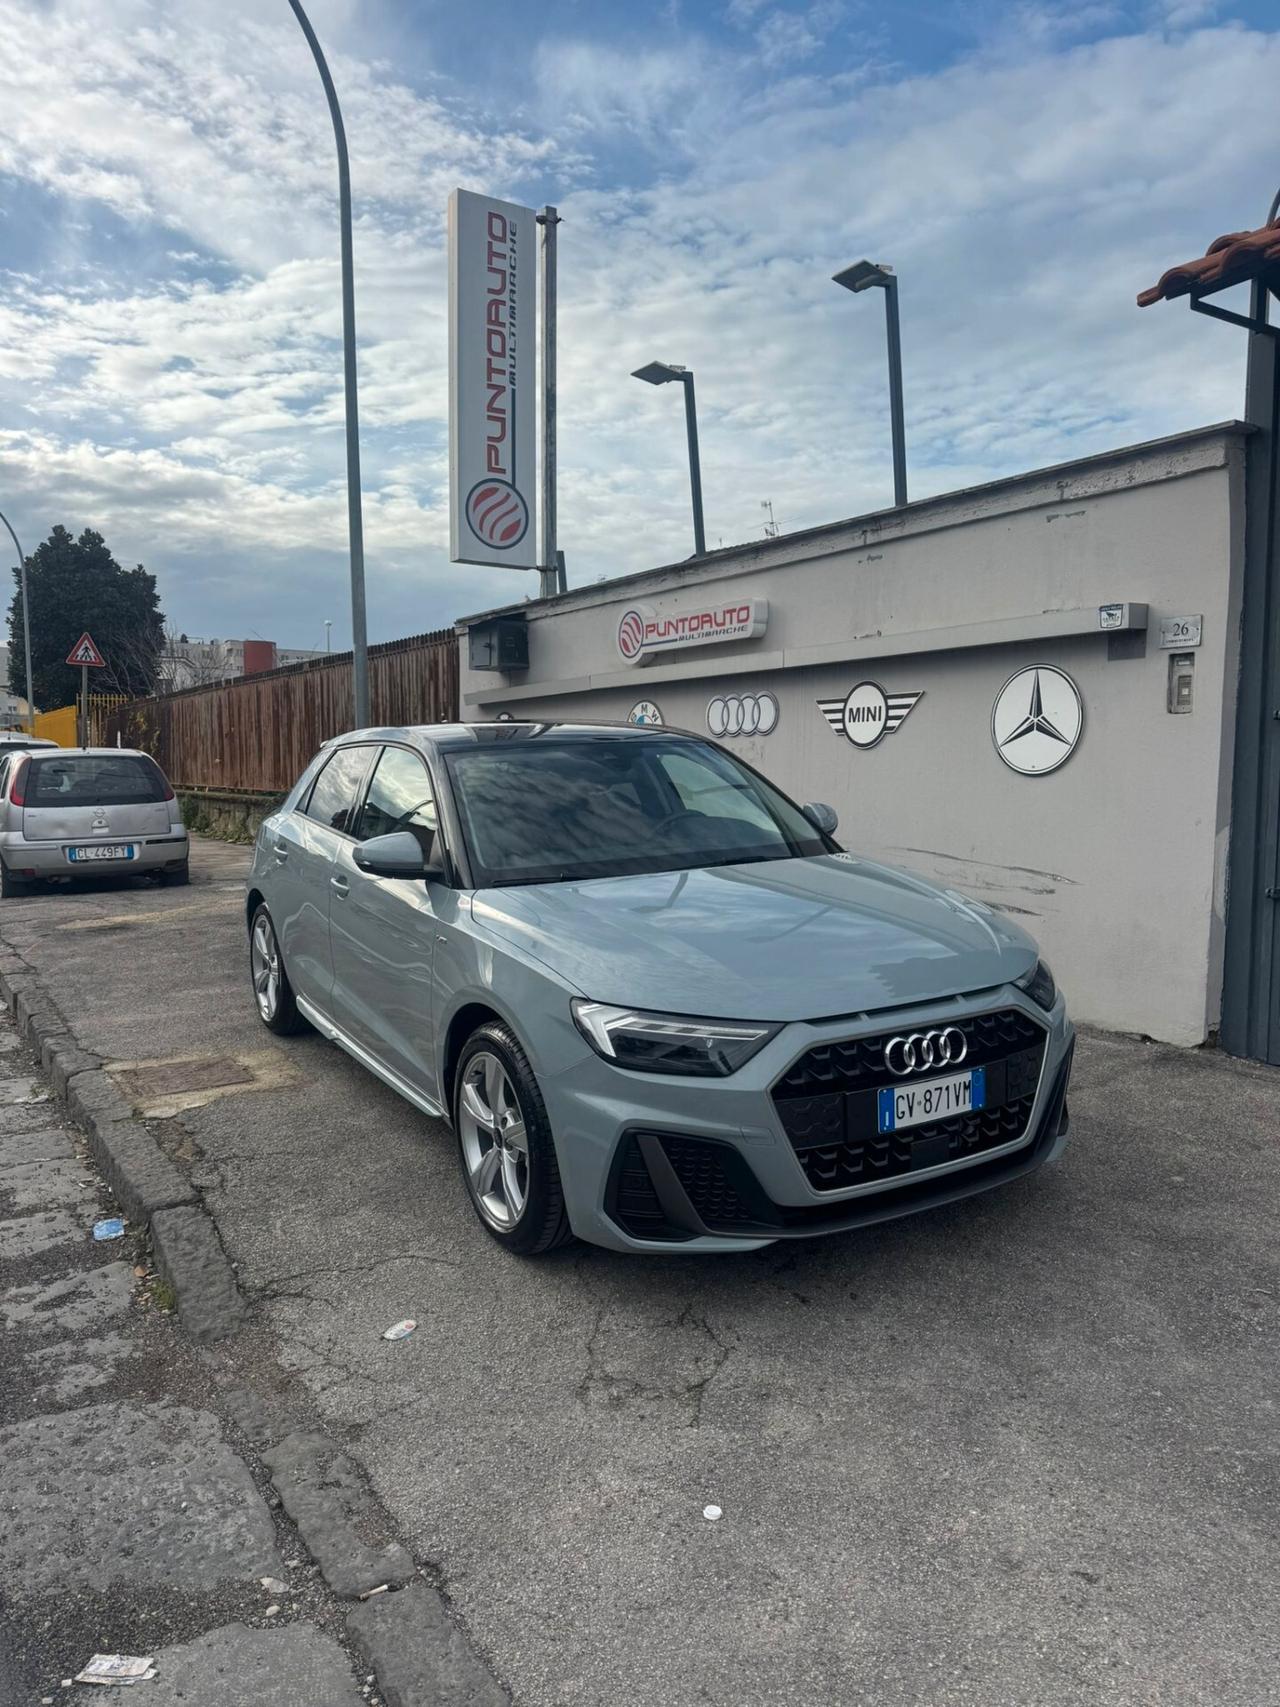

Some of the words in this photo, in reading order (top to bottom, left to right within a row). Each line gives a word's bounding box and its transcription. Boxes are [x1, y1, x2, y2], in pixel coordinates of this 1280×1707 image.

[509, 219, 517, 387] MULTIMARCHE
[486, 211, 507, 475] PUNTOAUTO
[645, 605, 750, 639] PUNTOAUTO
[679, 624, 749, 641] MULTIMARCHE
[1172, 622, 1189, 637] 26
[848, 705, 882, 723] MINI
